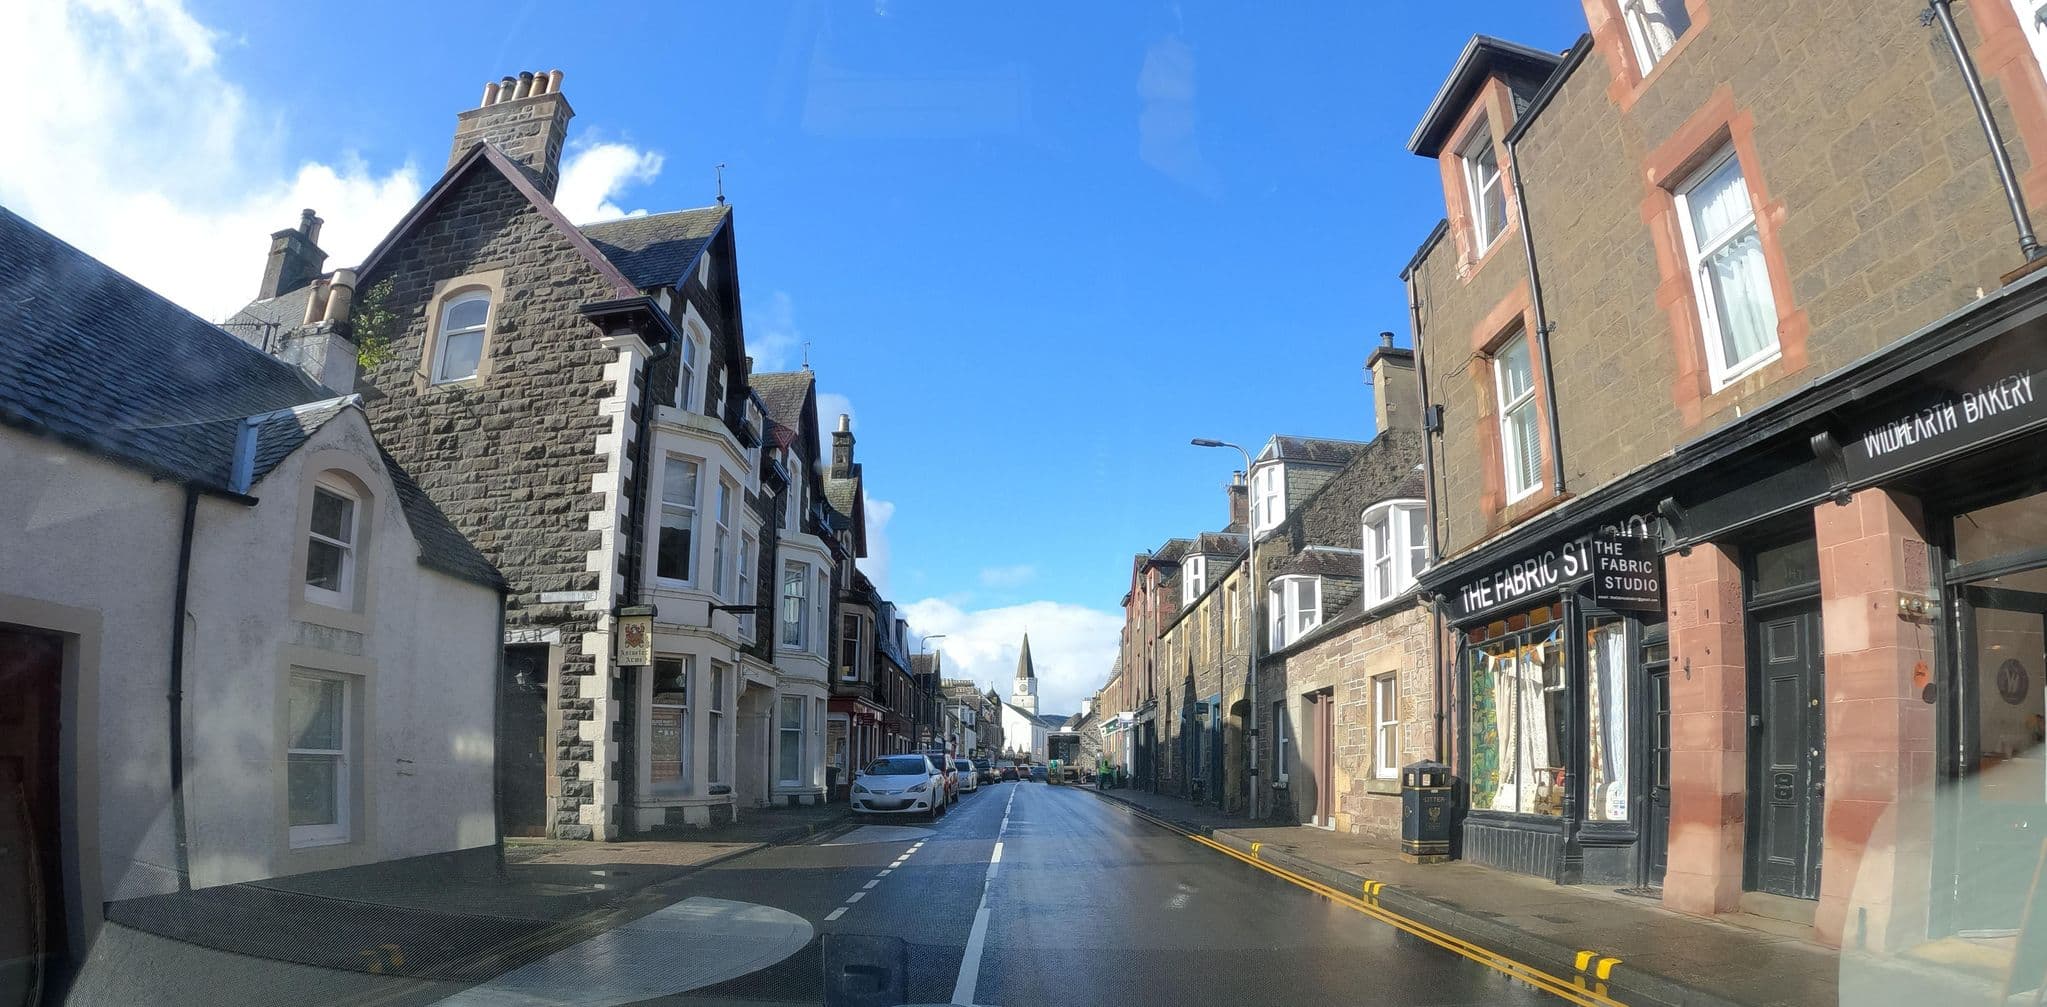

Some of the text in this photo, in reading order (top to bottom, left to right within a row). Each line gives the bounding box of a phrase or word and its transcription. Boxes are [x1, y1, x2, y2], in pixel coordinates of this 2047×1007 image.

[1863, 369, 2034, 458] WILDHEARTH BAKERY
[1594, 541, 1623, 556] THE
[1601, 557, 1653, 574] FABRIC
[1460, 577, 1494, 613] THE
[1494, 551, 1558, 602] FABRIC
[1605, 576, 1658, 592] STUDIO
[504, 629, 543, 642] BAR
